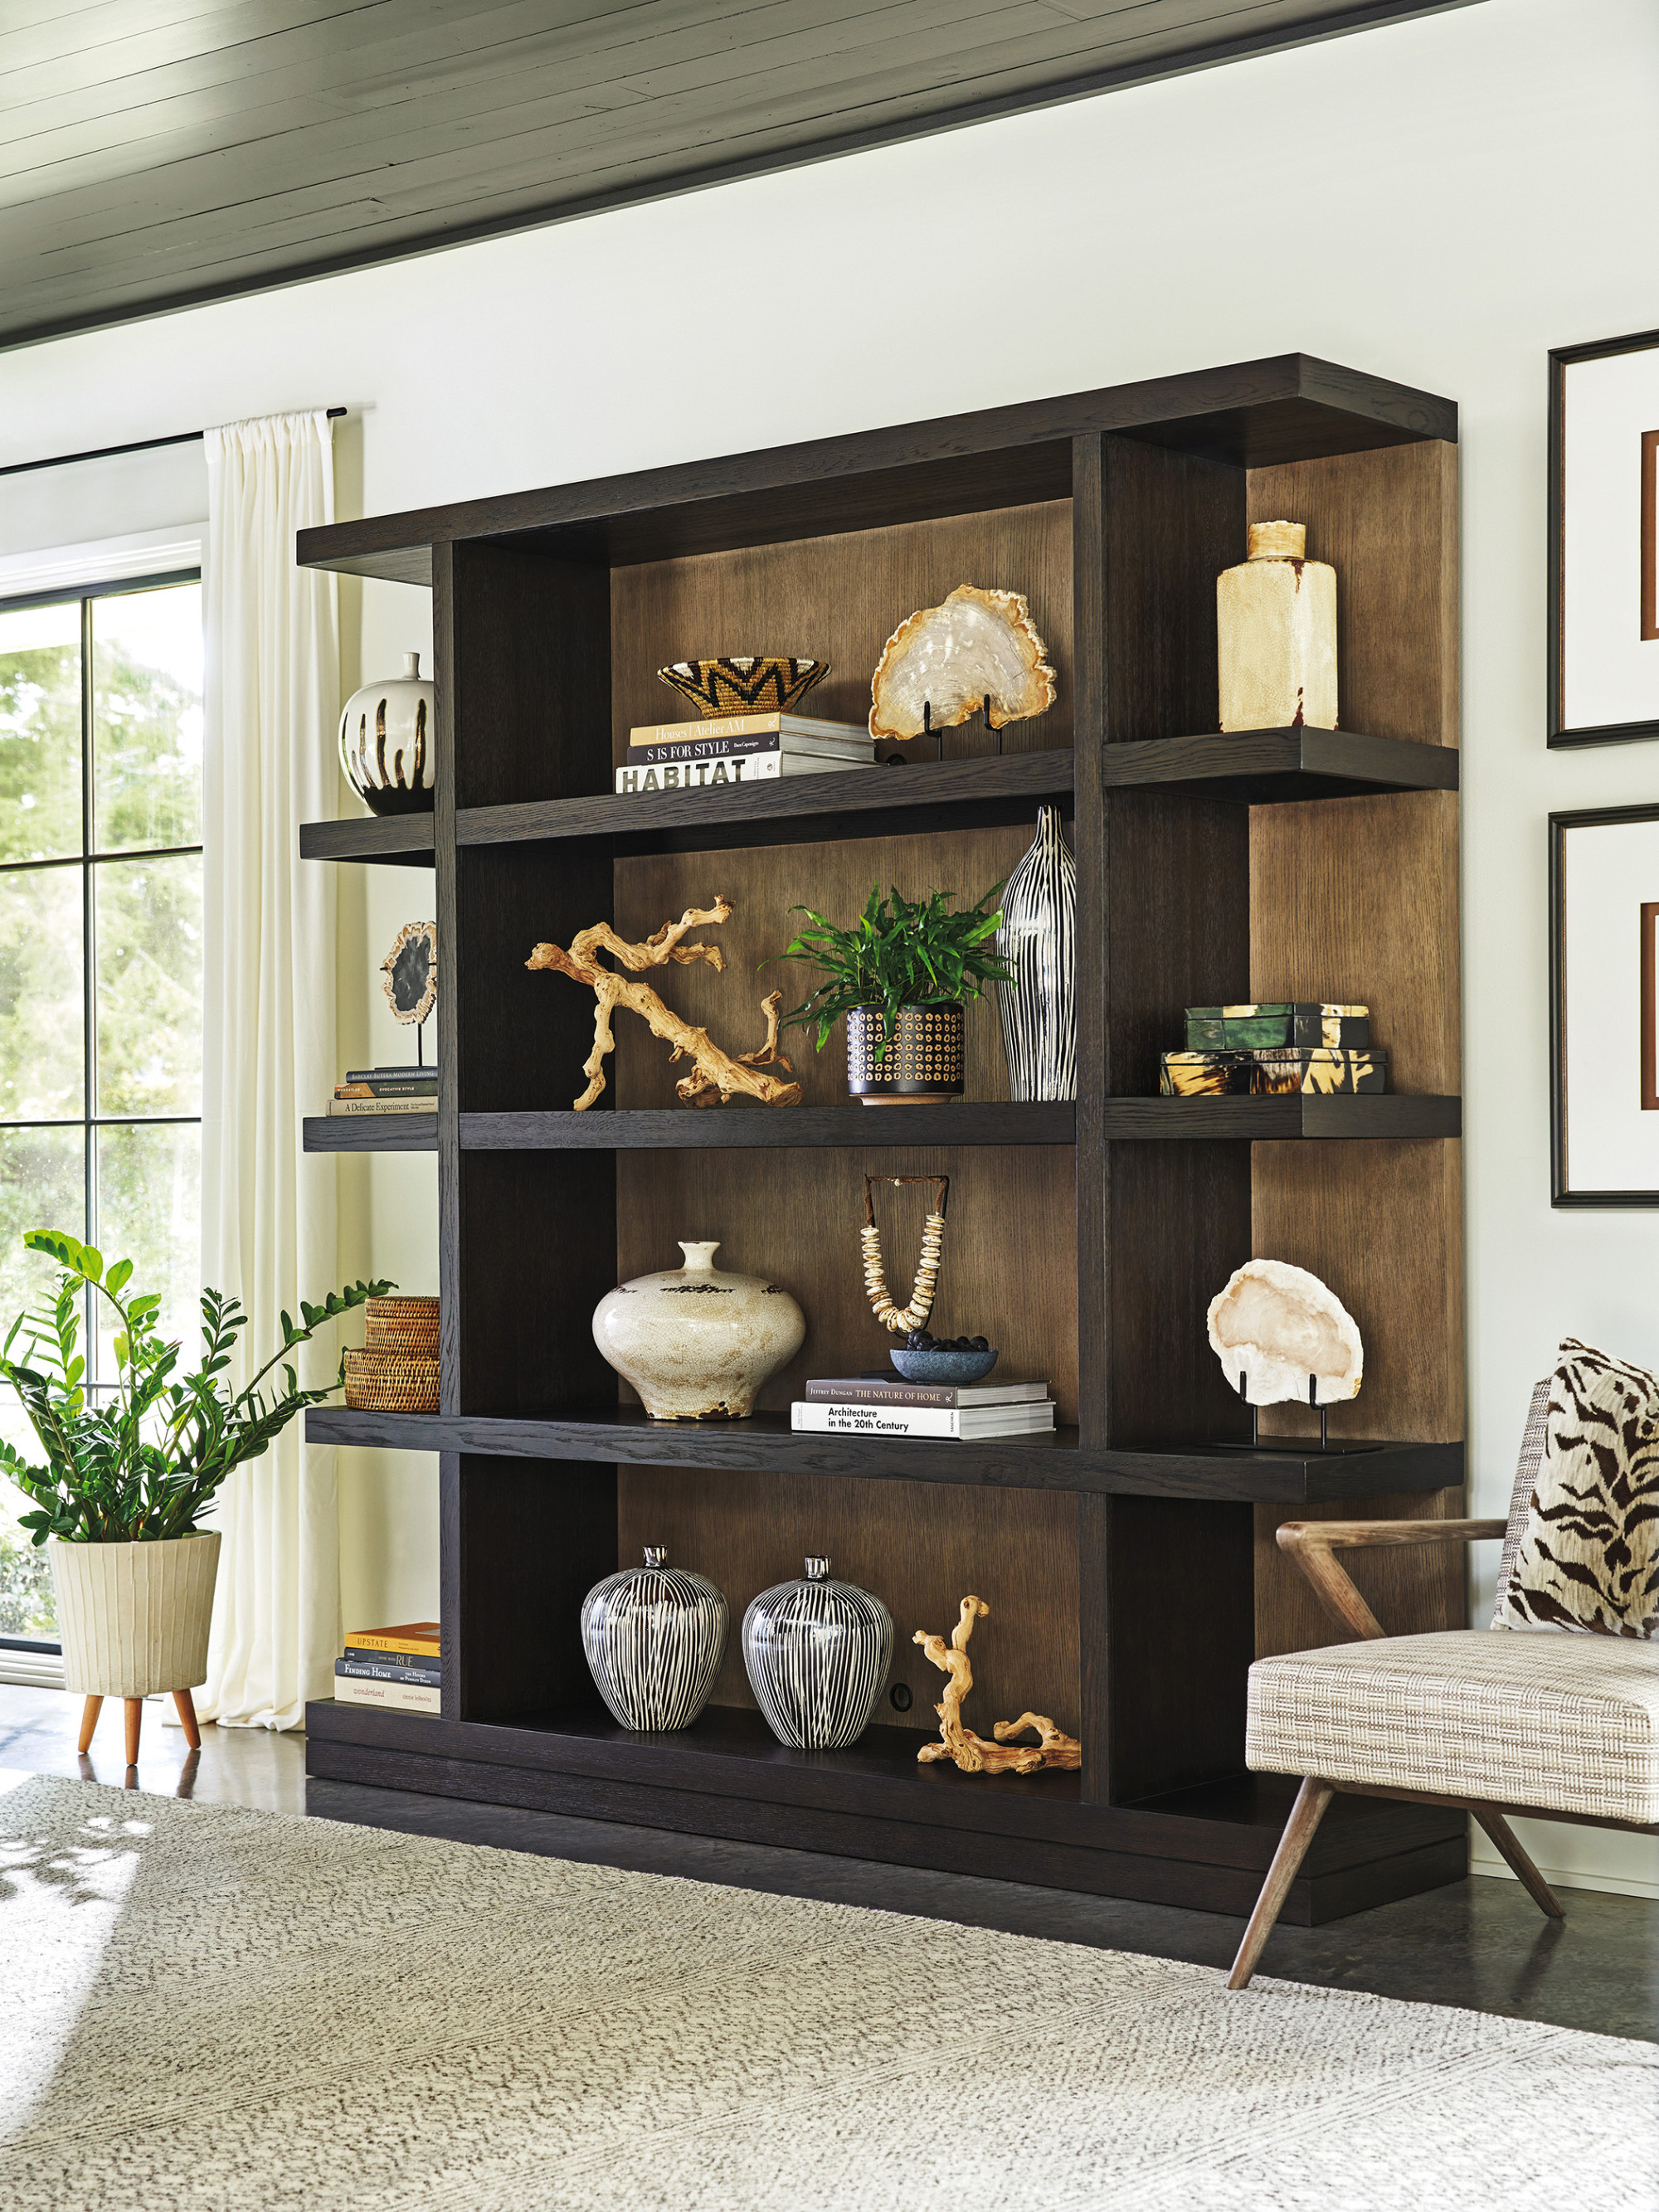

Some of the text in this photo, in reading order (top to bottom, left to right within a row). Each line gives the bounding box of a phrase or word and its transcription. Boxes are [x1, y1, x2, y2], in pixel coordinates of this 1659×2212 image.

[655, 727, 688, 741] Houses
[694, 722, 725, 737] Atelier
[727, 719, 745, 733] AM
[647, 740, 730, 761] S IS FOR STYLE
[623, 758, 746, 793] HABITAT
[345, 1103, 351, 1112] A
[351, 1102, 375, 1111] Delicate
[376, 1101, 409, 1112] Experiment
[855, 1389, 941, 1402] THE NATURE OF HOME
[828, 1407, 878, 1417] Architecture
[828, 1418, 909, 1432] in the 20th Century
[357, 1637, 388, 1648] UPSTATE
[396, 1655, 414, 1667] RUE
[344, 1663, 392, 1678] FINDING HOME
[353, 1687, 385, 1698] wonderland
